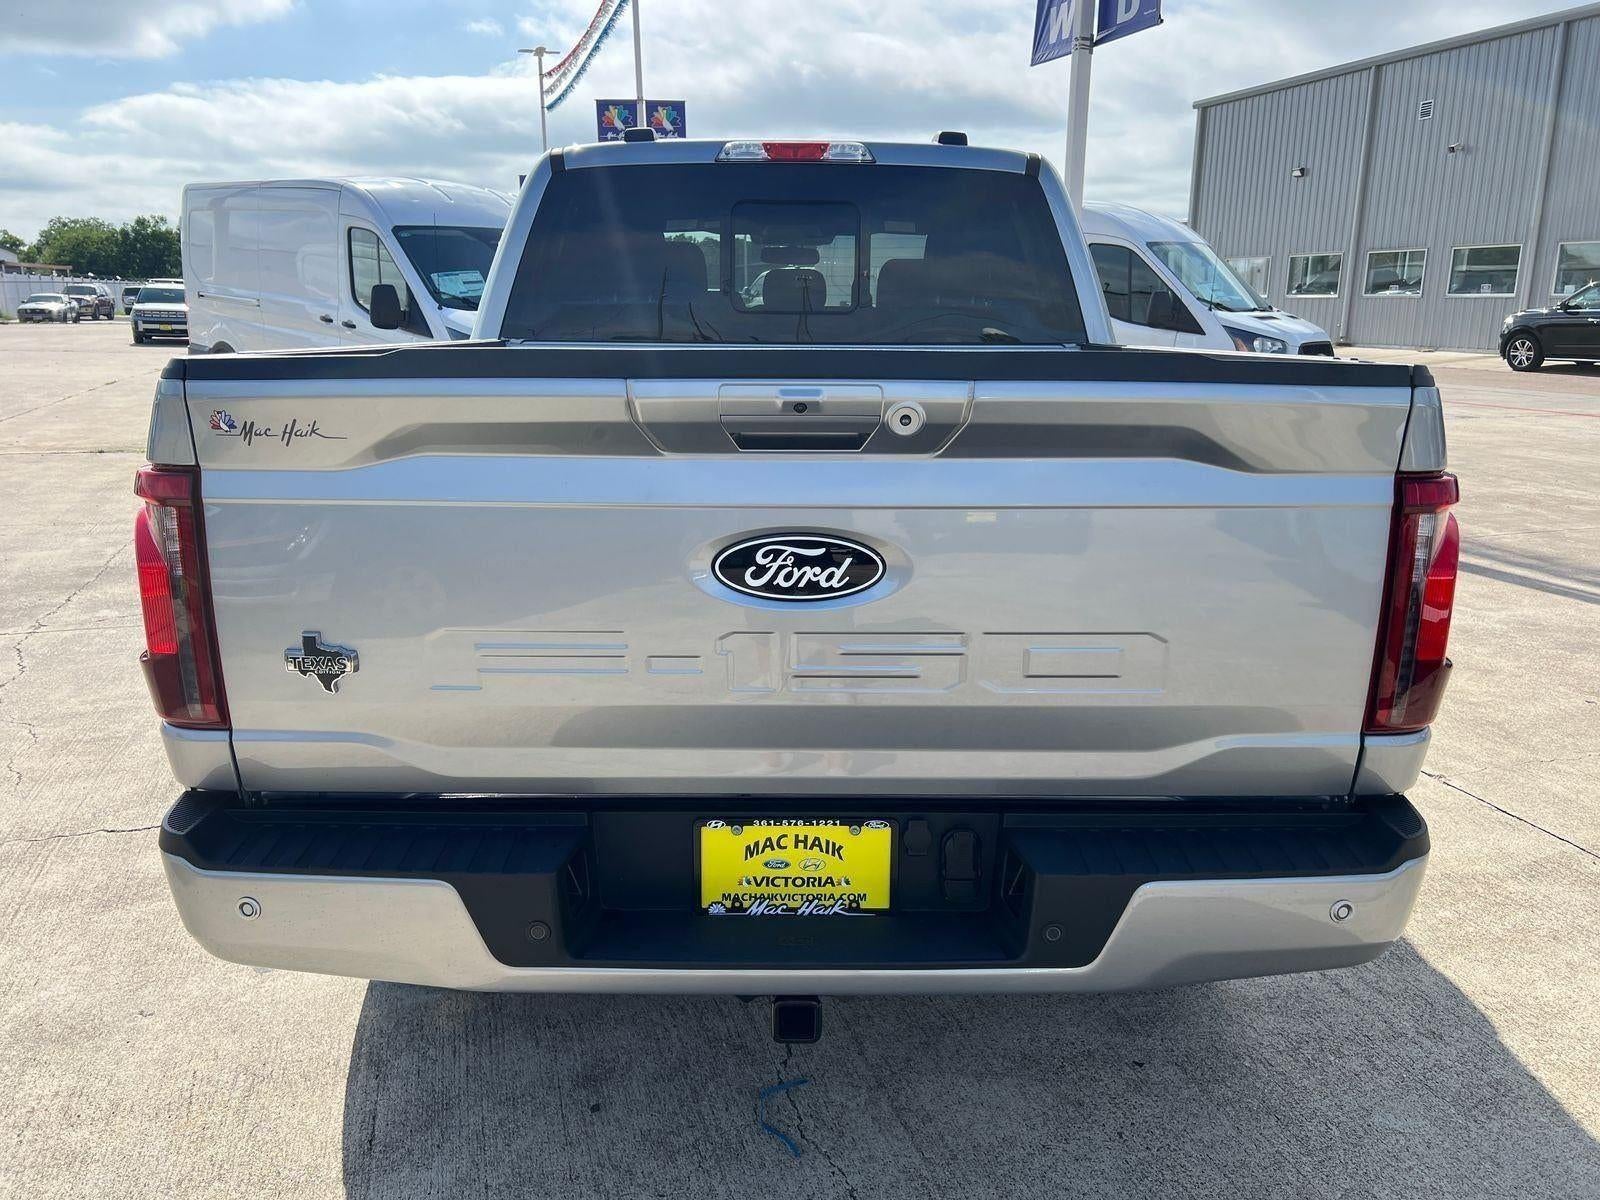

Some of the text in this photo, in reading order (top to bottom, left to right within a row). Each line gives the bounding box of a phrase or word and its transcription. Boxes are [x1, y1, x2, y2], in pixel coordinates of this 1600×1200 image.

[239, 418, 331, 447] Mac Haik
[744, 545, 853, 589] Ford
[288, 656, 348, 670] TEXAS
[430, 628, 1168, 695] F-150
[753, 819, 840, 827] 361-576-1221
[744, 833, 845, 861] MAC HAIK
[752, 876, 836, 888] VICTORIA
[746, 899, 854, 916] Mac Haik
